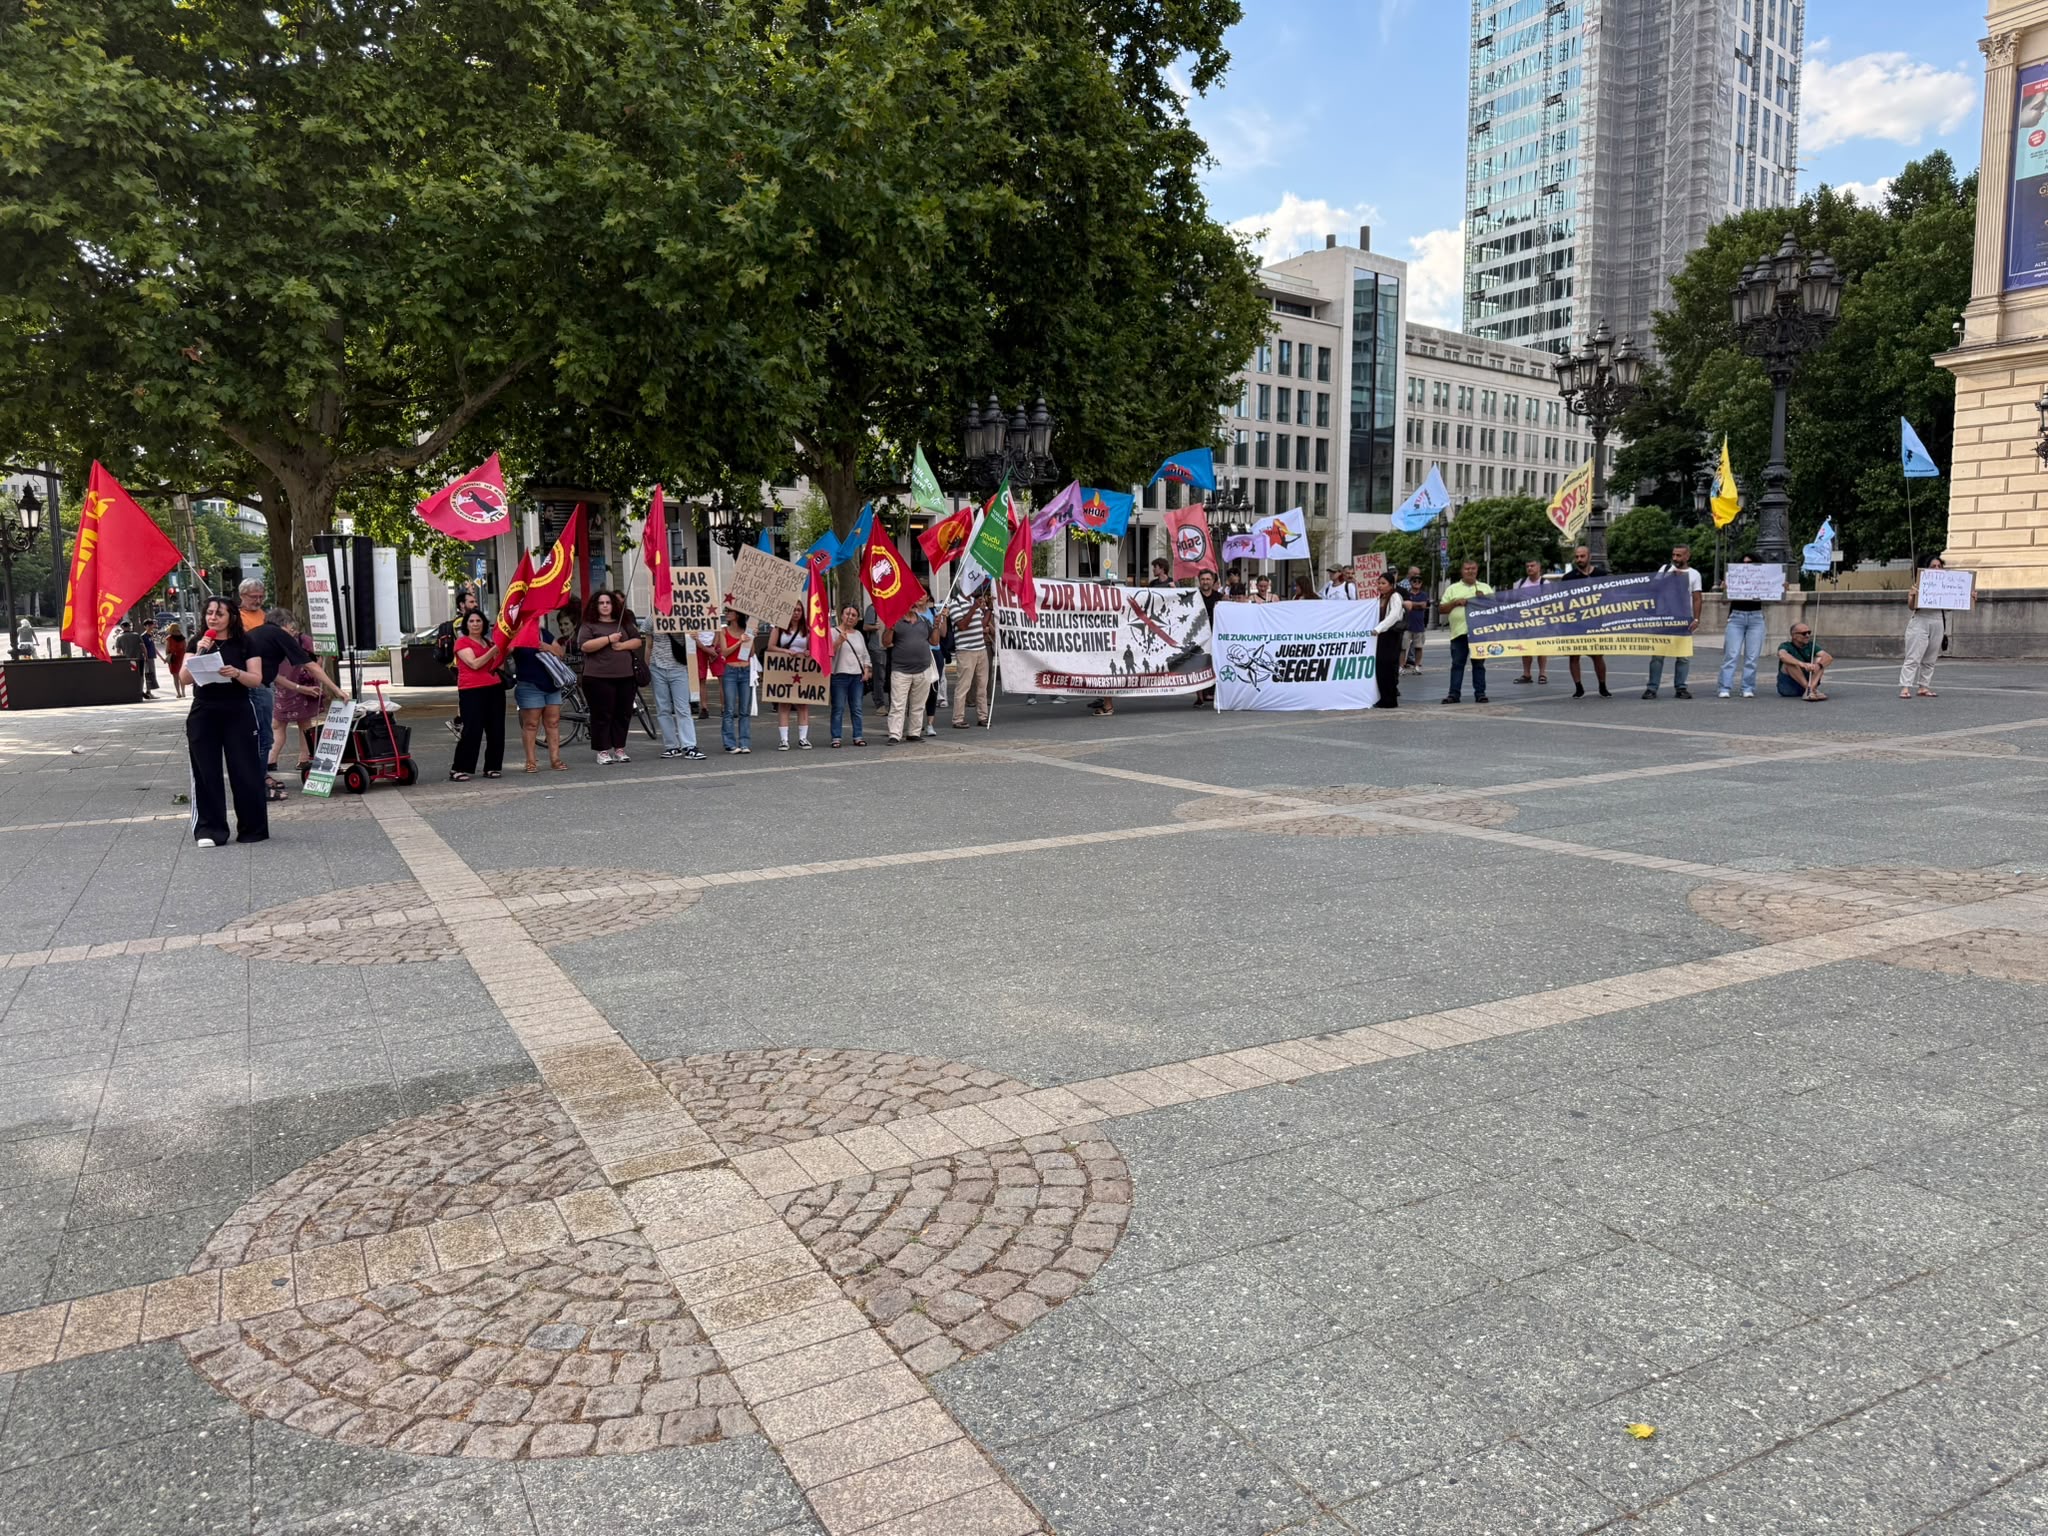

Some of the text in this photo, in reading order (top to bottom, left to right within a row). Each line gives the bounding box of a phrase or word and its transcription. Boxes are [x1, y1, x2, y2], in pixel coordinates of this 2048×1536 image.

[742, 549, 768, 568] WHEN
[768, 560, 782, 573] THE
[1356, 554, 1381, 564] KEINE
[1356, 560, 1382, 571] MACHT
[677, 572, 708, 586] WAR
[735, 572, 783, 598] THE LOVE OF
[741, 562, 798, 592] OF LOVE BEATS
[674, 590, 710, 604] MASS
[732, 583, 760, 600] POWER
[1040, 584, 1076, 611] ZUR
[1080, 584, 1126, 614] NATO,
[1468, 576, 1650, 618] GEGEN IMPERIALISMUS UND FASCHISMUS
[1520, 593, 1602, 620] STEH AUF
[656, 616, 719, 632] FOR PROFIT
[999, 609, 1018, 626] DER
[1472, 598, 1656, 636] GEWINNE DIE ZUKUNFT!
[1612, 623, 1632, 632] KALK
[999, 628, 1117, 653] KRIEGSMASCHINE!
[1218, 633, 1230, 641] DIE
[1230, 634, 1268, 642] ZUKUNFT
[1269, 633, 1292, 641] LIEGT
[1294, 633, 1304, 641] IN
[1304, 632, 1344, 641] UNSEREN
[1536, 636, 1598, 646] KONFÖDERATION
[1599, 636, 1614, 644] DER
[1275, 640, 1366, 658] JUGEND STEHT AUF
[766, 656, 800, 673] MAKE
[1272, 656, 1376, 683] GEGEN NATO
[1042, 674, 1051, 685] ES
[1052, 675, 1068, 686] LEBE
[1070, 676, 1083, 688] DER
[1085, 676, 1126, 688] WIDERSTAND
[1127, 676, 1139, 687] DER
[1140, 674, 1188, 688] UNTERDRÜCKTEN
[766, 684, 826, 701] NOT WAR
